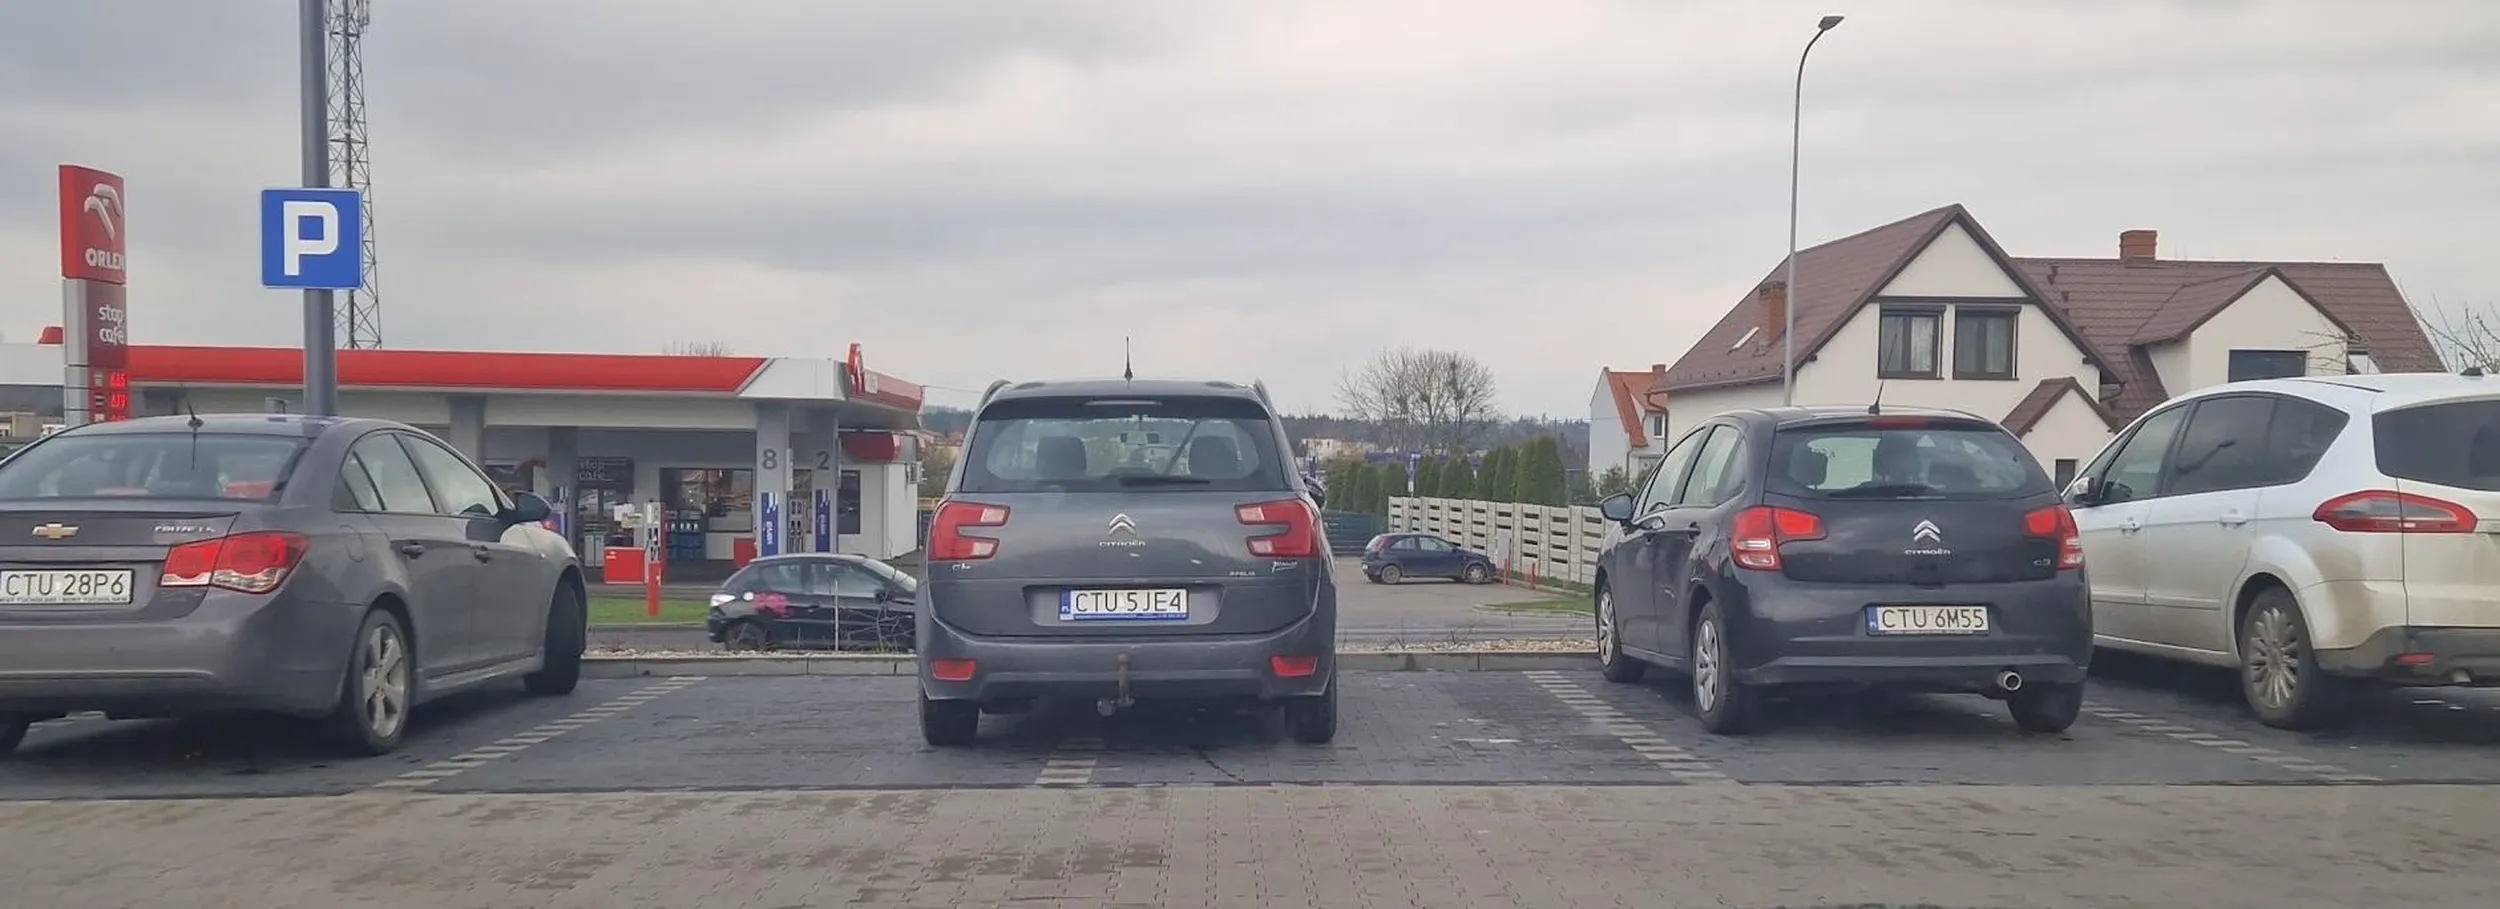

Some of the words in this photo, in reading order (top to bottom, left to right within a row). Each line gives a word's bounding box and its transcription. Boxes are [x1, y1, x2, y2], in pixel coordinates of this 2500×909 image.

[283, 200, 338, 276] P
[99, 304, 124, 328] stop
[763, 449, 777, 470] 8
[817, 451, 830, 470] 2
[6, 573, 53, 596] CTU
[62, 573, 124, 596] 28P6
[1075, 592, 1118, 612] CTU
[1126, 591, 1181, 612] 5JE4
[1882, 609, 1927, 628] CTU
[1935, 609, 1984, 628] 6M55
